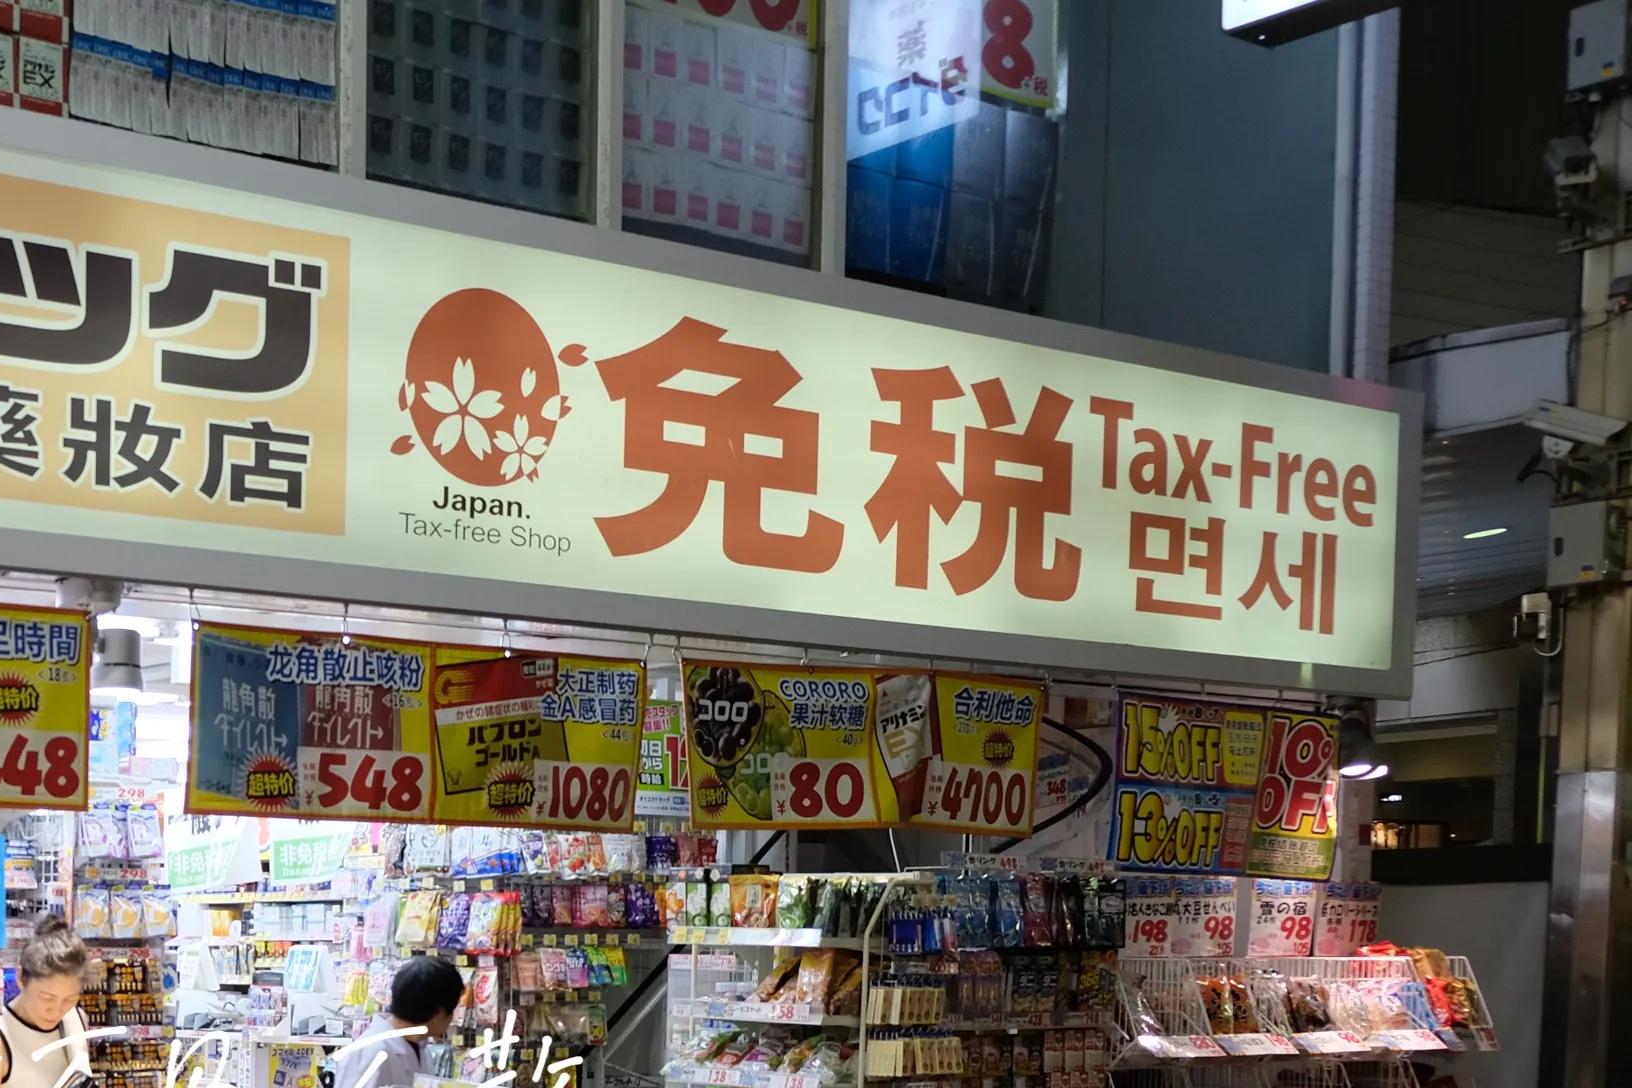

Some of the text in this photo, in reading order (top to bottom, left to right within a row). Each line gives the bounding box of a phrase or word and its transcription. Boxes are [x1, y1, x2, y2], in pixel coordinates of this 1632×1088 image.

[593, 316, 1082, 602] 免税
[1089, 395, 1378, 528] Tax-Free
[398, 511, 572, 556] Tax-free Shop
[1127, 511, 1338, 635] 면세
[269, 647, 421, 688] 龙角散止咳粉
[558, 671, 637, 696] 大正制药
[780, 680, 867, 700] CORORO
[222, 678, 276, 720] 龍角散
[541, 694, 637, 723] 金A感冒药
[954, 688, 1035, 725] 合利他命
[791, 704, 866, 729] 果汁软糖
[880, 705, 926, 733] アリナミン
[468, 719, 541, 746] パブロン
[119, 868, 147, 879] 298
[1260, 901, 1307, 915] 雪の宿
[1133, 919, 1167, 943] 198
[1204, 915, 1233, 940] 98
[1280, 916, 1312, 940] 98
[708, 1070, 727, 1083] 138
